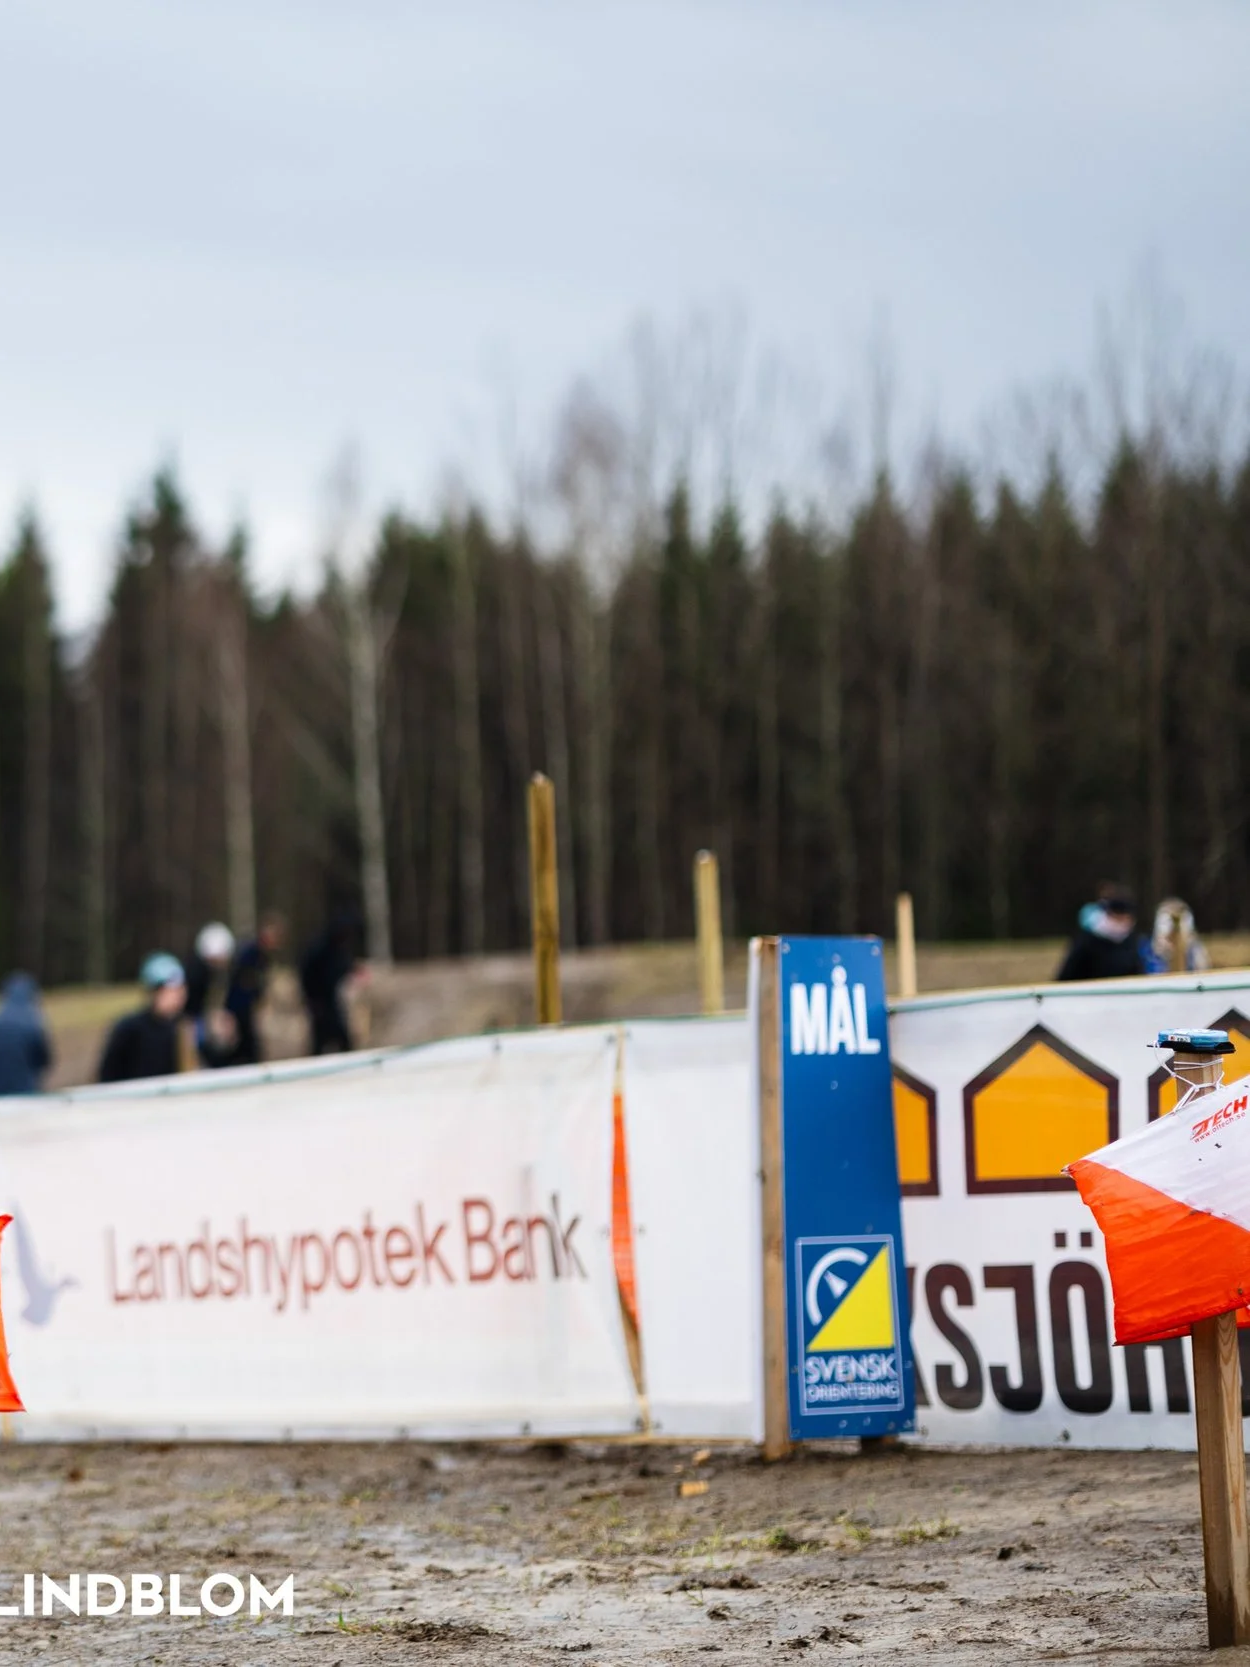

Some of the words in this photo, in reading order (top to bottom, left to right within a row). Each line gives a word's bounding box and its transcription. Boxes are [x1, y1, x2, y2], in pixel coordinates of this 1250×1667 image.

[790, 965, 881, 1055] MÅL
[104, 1202, 457, 1312] Landshypotek
[461, 1190, 589, 1285] Bank
[805, 1353, 897, 1384] SVENSK
[805, 1381, 900, 1402] ORIENTERING
